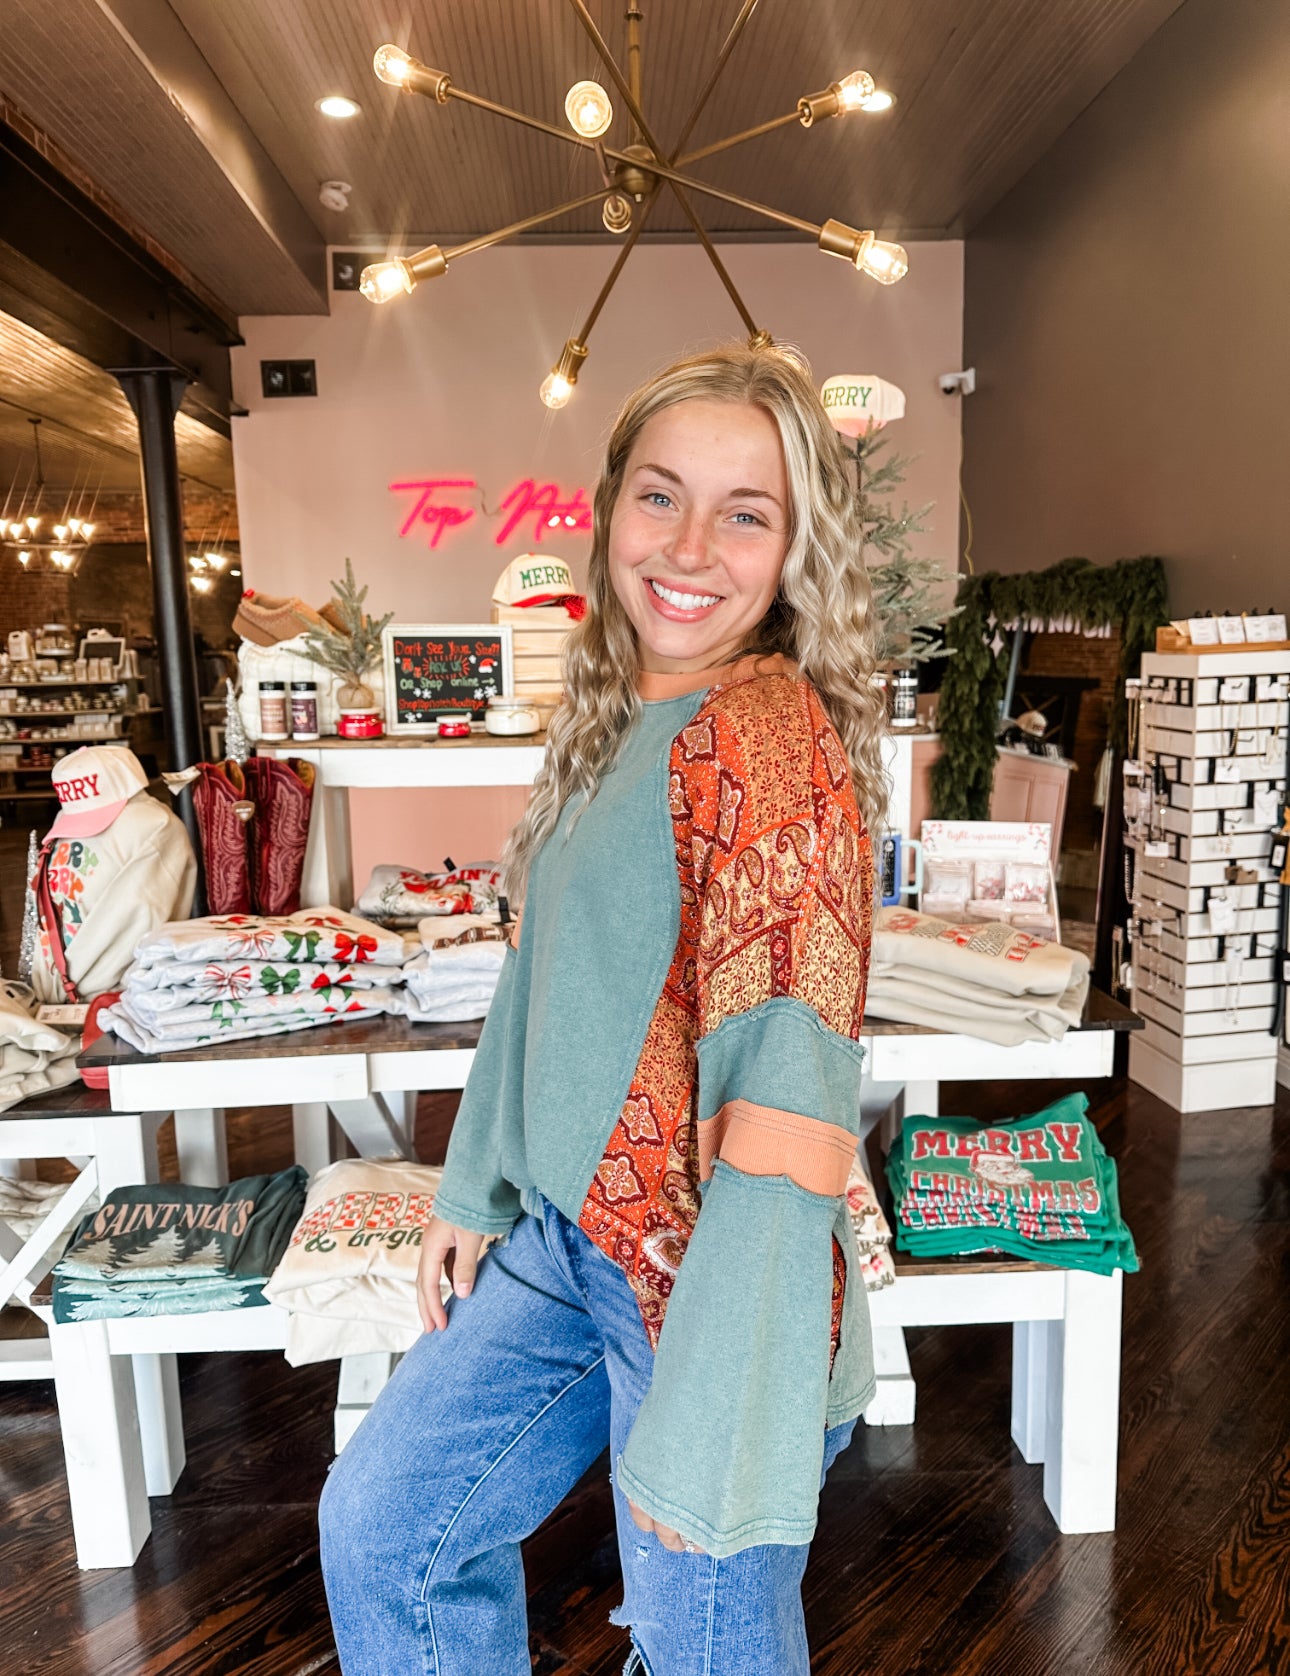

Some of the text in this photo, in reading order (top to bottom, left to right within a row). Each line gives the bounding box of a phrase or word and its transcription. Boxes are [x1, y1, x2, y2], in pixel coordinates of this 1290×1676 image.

[823, 386, 872, 408] ERRY
[389, 480, 475, 548] Top
[426, 641, 444, 655] See
[911, 1122, 1084, 1163] MERRY
[910, 1170, 1101, 1214] CHRISTMAS
[83, 1198, 255, 1241] SAINT NICK'S
[287, 1191, 436, 1249] MERR
[303, 1226, 424, 1253] & brigh
